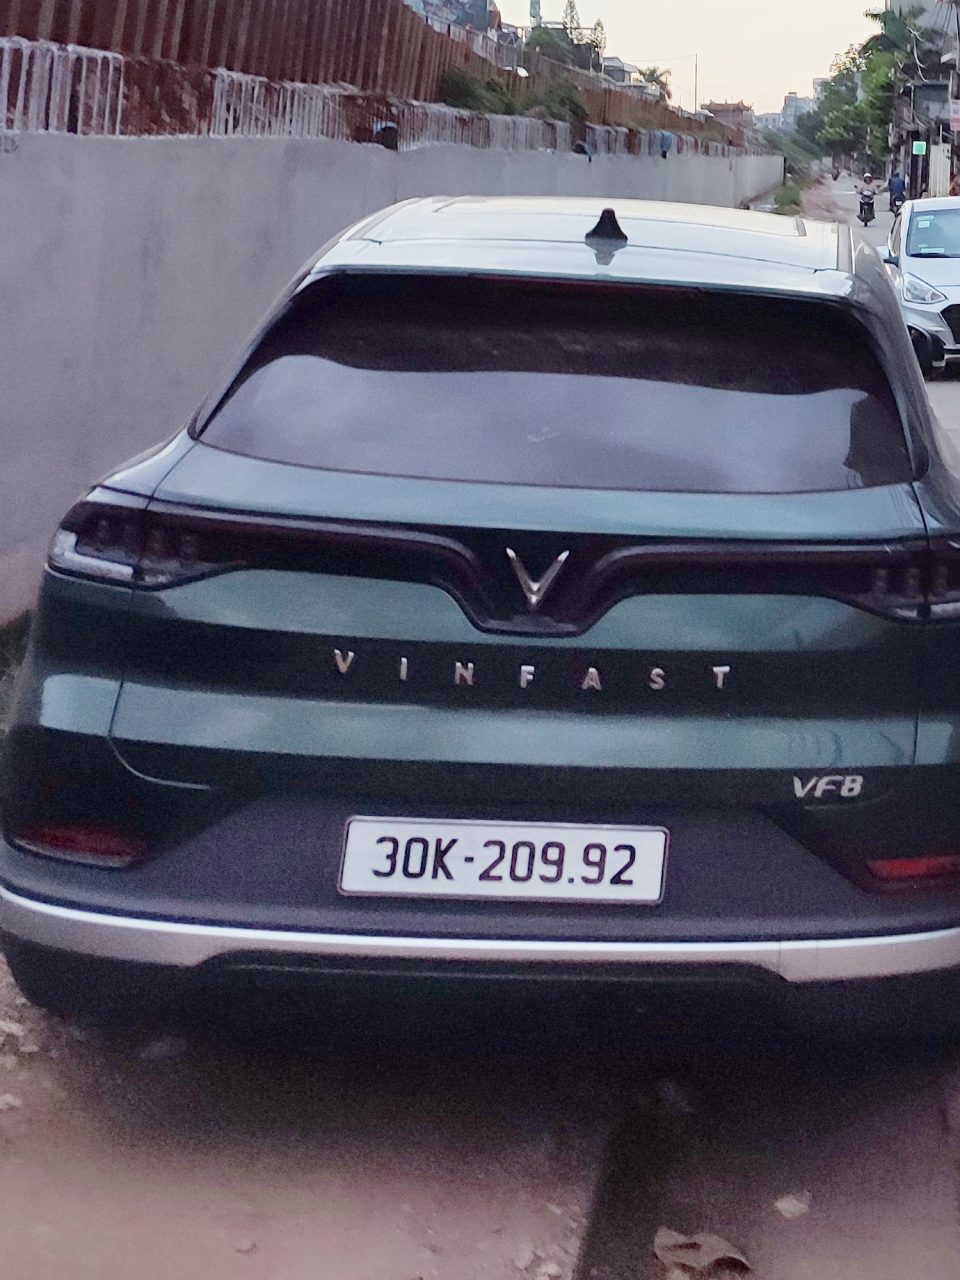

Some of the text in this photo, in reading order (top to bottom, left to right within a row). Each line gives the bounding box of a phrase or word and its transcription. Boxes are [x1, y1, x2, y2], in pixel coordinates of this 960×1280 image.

[333, 648, 731, 691] VINFAST
[792, 774, 864, 798] VF8
[371, 836, 637, 886] 30K-209.92
